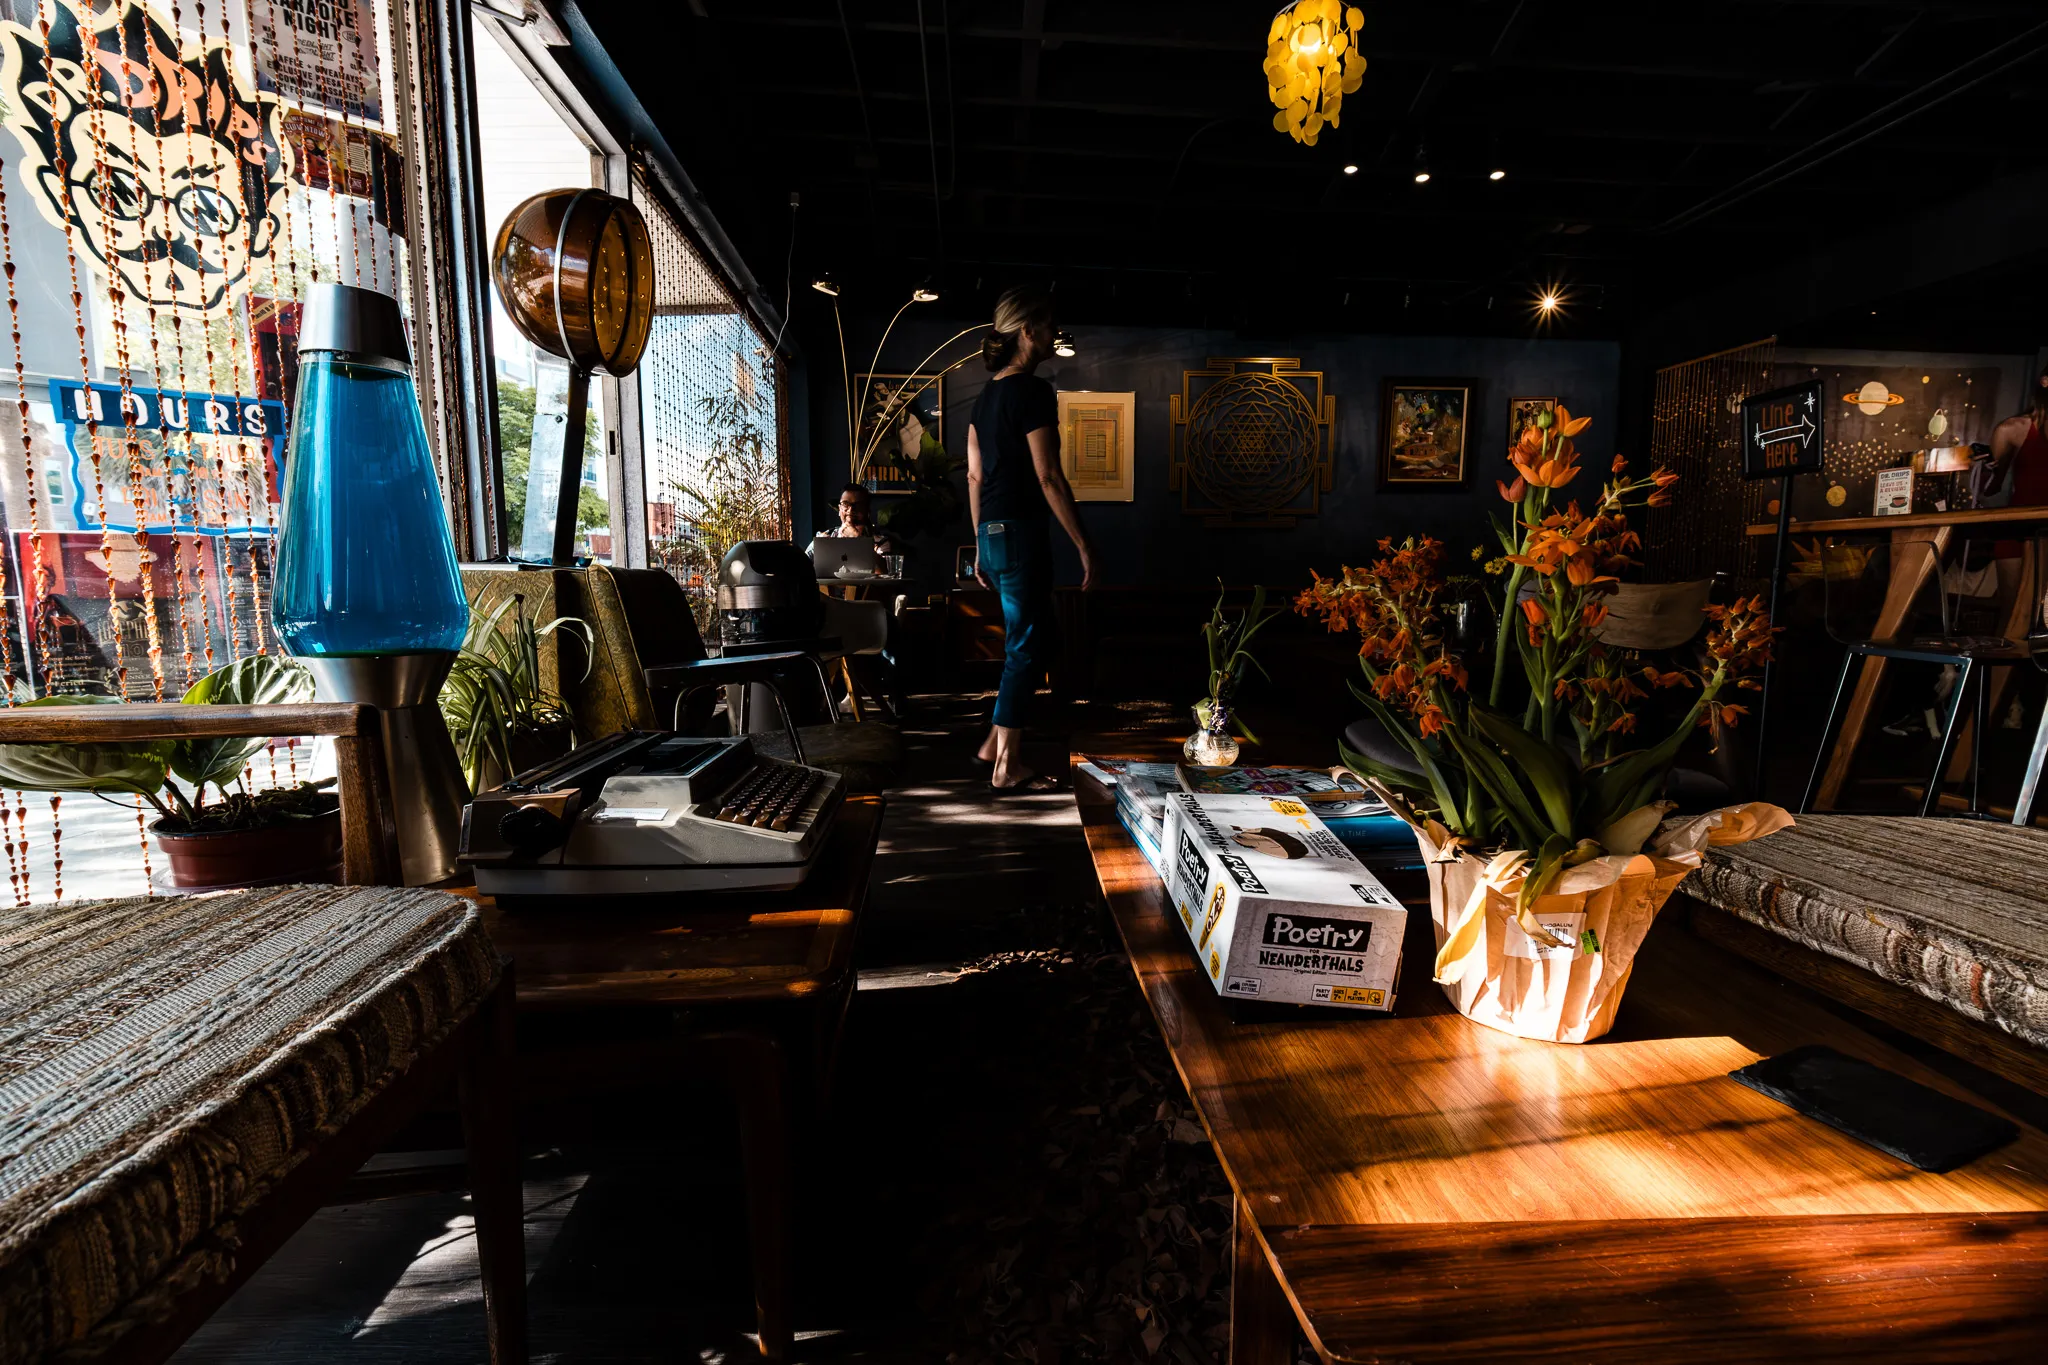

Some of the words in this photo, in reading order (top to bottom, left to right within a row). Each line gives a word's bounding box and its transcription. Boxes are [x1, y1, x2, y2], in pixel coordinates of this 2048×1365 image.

[283, 8, 339, 41] NIGHT
[267, 60, 313, 80] ECLUSIVE
[315, 75, 352, 91] PESAE
[278, 72, 313, 89] COWOY
[22, 57, 117, 122] DR.
[93, 37, 275, 166] DRIPS
[74, 389, 268, 435] HOURS
[94, 436, 155, 461] TUS
[1765, 442, 1798, 469] Here
[1181, 832, 1207, 886] Poetry
[1224, 855, 1266, 894] Poetry
[1272, 916, 1364, 948] Poetry
[1259, 950, 1365, 973] NEANDERTHALS
